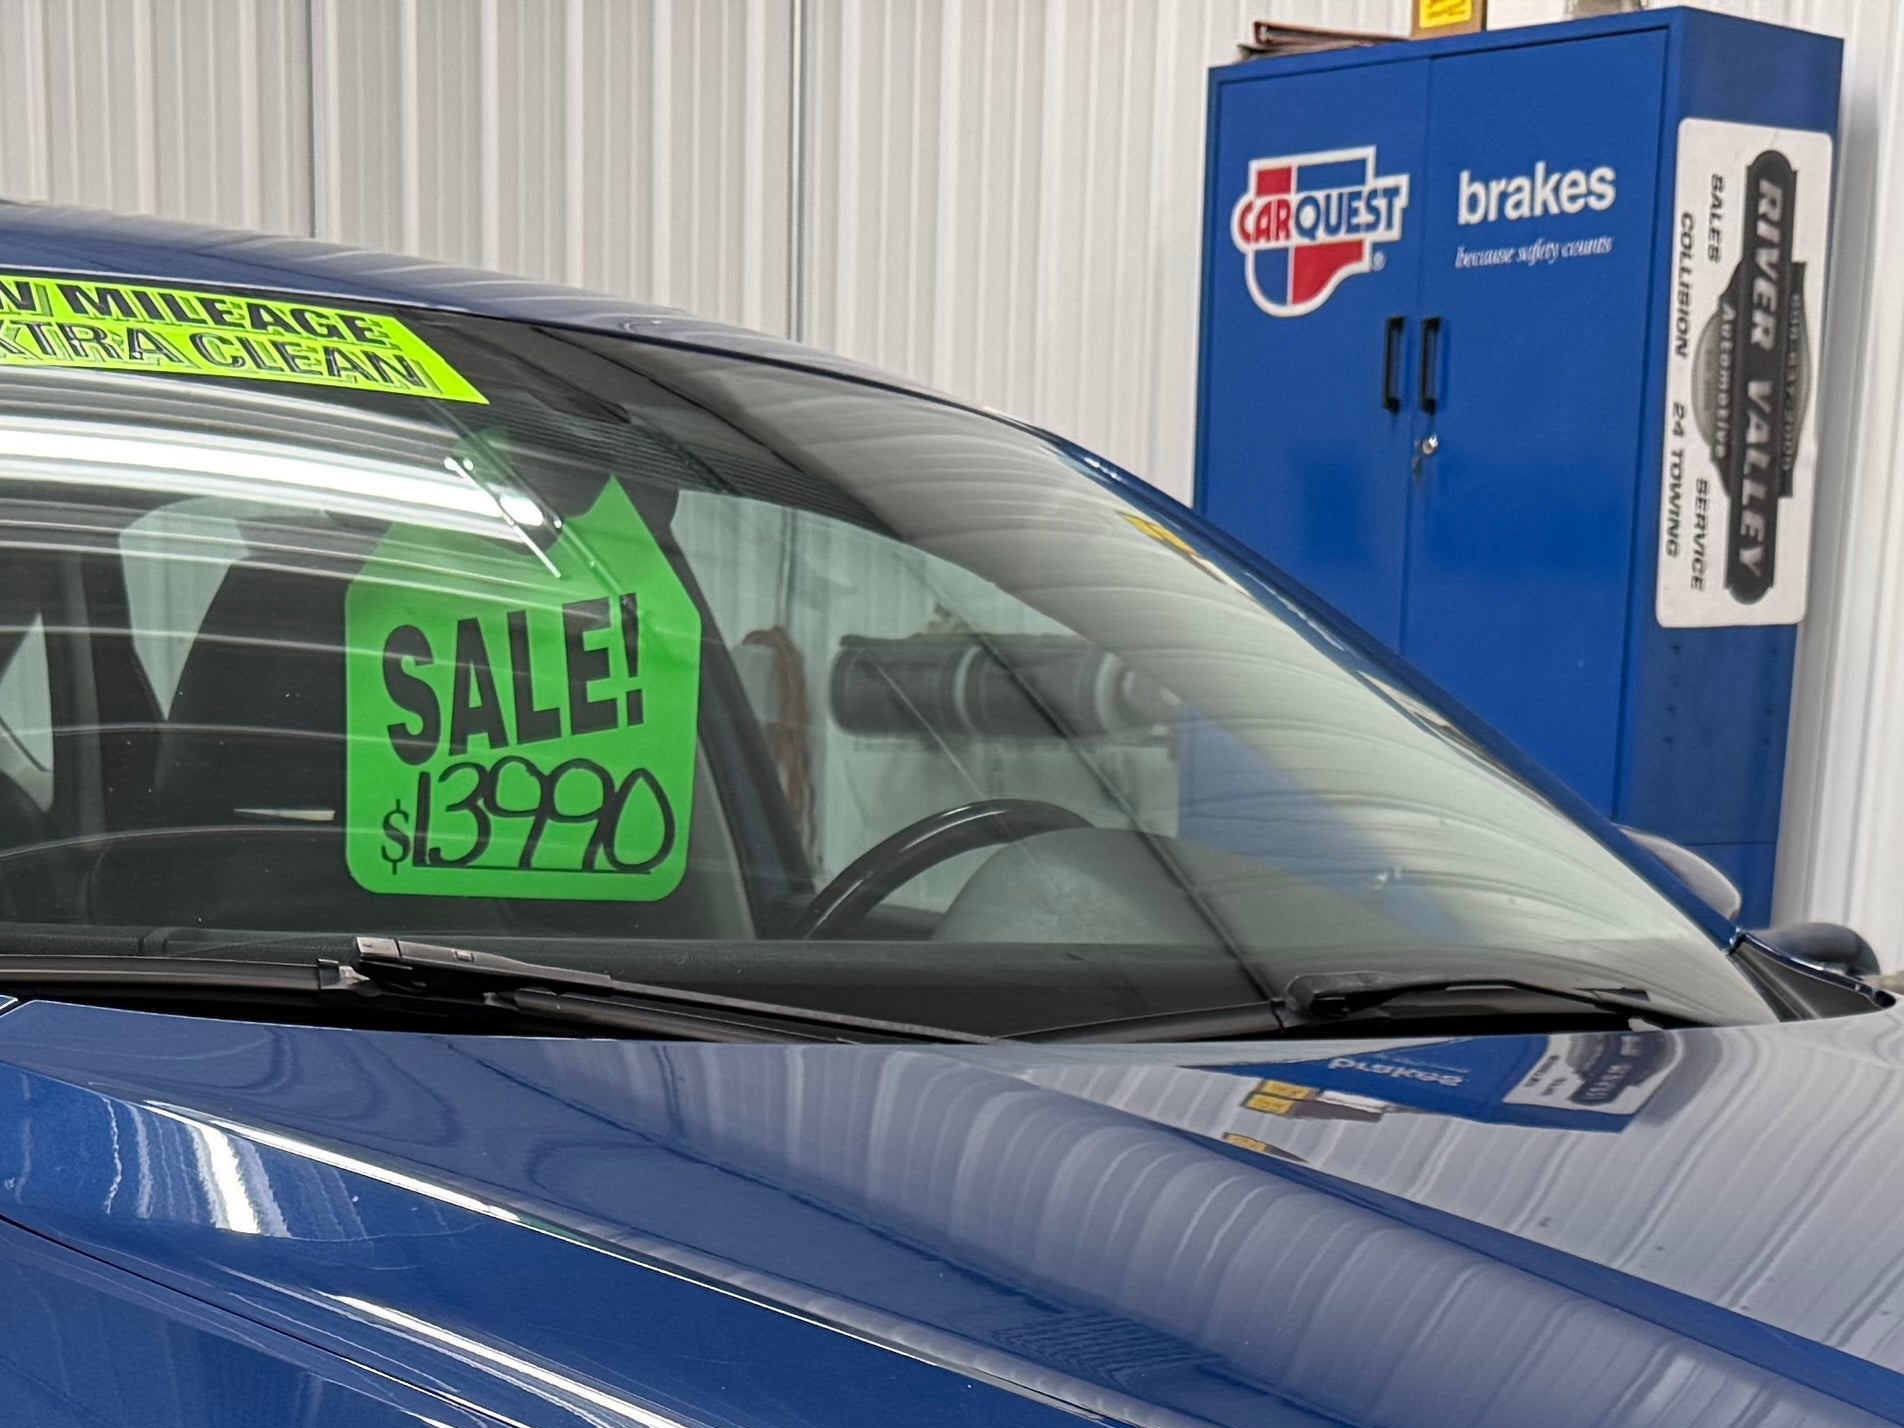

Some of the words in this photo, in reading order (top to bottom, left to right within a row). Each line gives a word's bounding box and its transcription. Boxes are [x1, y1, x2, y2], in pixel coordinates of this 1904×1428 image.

[1238, 185, 1400, 244] CARQUEST
[1457, 160, 1616, 225] brakes
[1707, 173, 1725, 264] SALES
[1455, 246, 1515, 269] because
[1516, 238, 1560, 267] safety
[1561, 236, 1614, 259] counts
[1674, 212, 1695, 359] COLLISION
[1750, 178, 1784, 351] RIVER
[56, 282, 396, 347] MILEAGE
[190, 331, 432, 390] CLEAN
[1672, 402, 1686, 438] 24
[1714, 302, 1737, 459] Automotive
[1666, 448, 1685, 558] TOWING
[1739, 380, 1773, 578] VALLEY
[1690, 478, 1711, 592] SERVICE
[382, 592, 644, 766] SALE!
